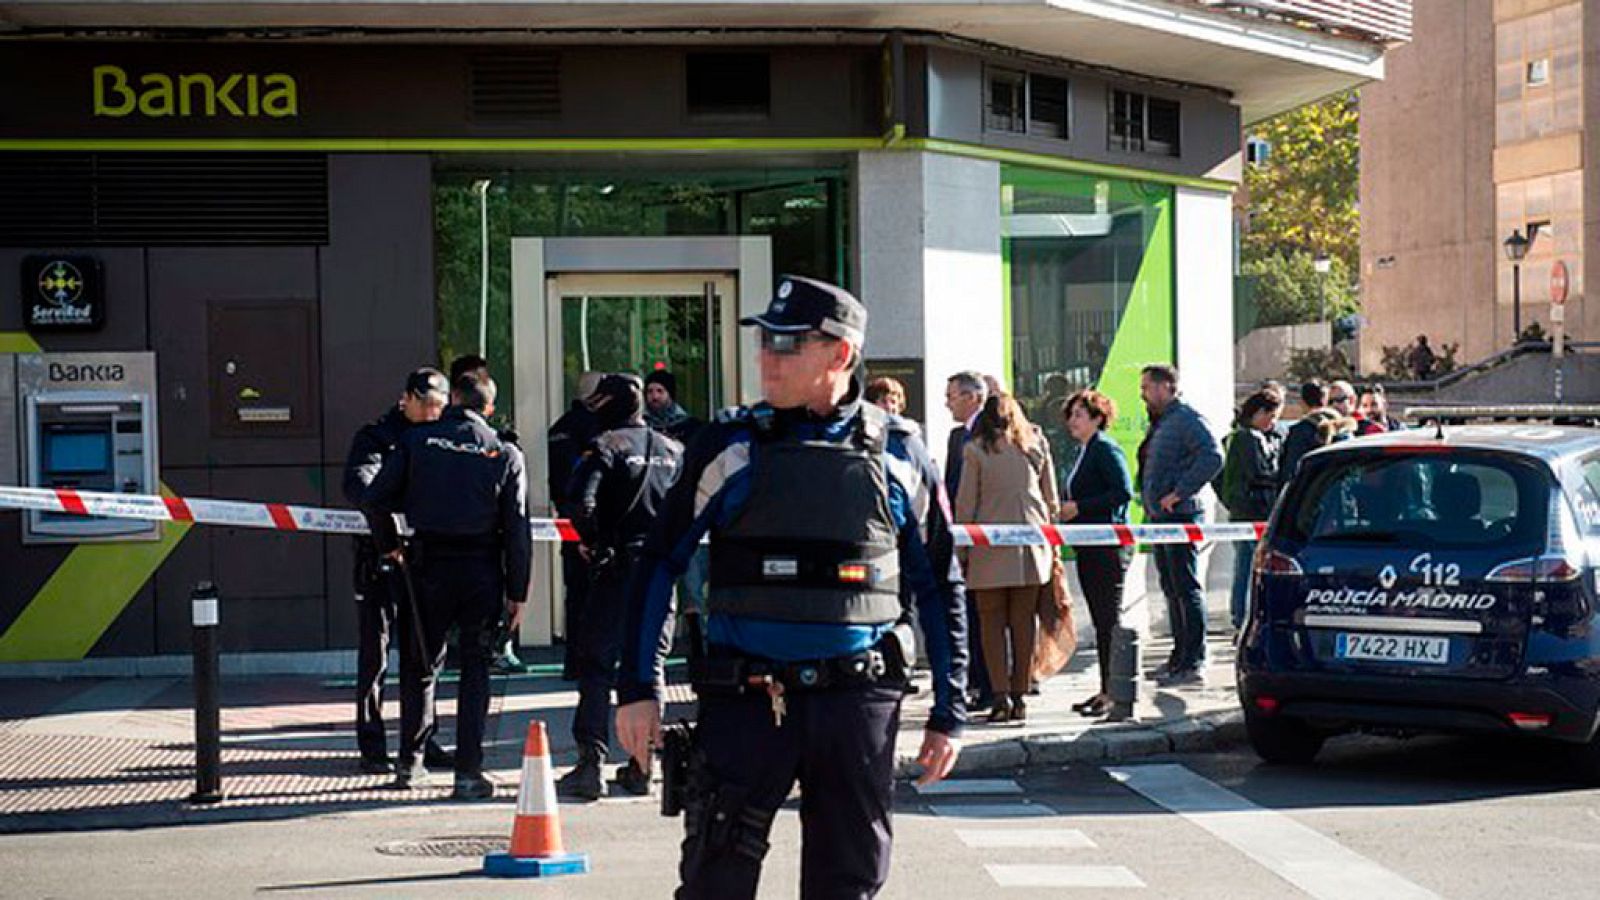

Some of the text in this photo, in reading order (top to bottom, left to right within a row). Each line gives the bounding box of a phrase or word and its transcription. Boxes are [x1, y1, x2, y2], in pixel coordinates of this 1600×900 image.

[93, 65, 299, 118] Bankia
[49, 362, 124, 381] Bankia
[1421, 563, 1460, 586] 112
[1391, 591, 1496, 609] MADRID
[1349, 635, 1445, 659] 7422 HXJ
